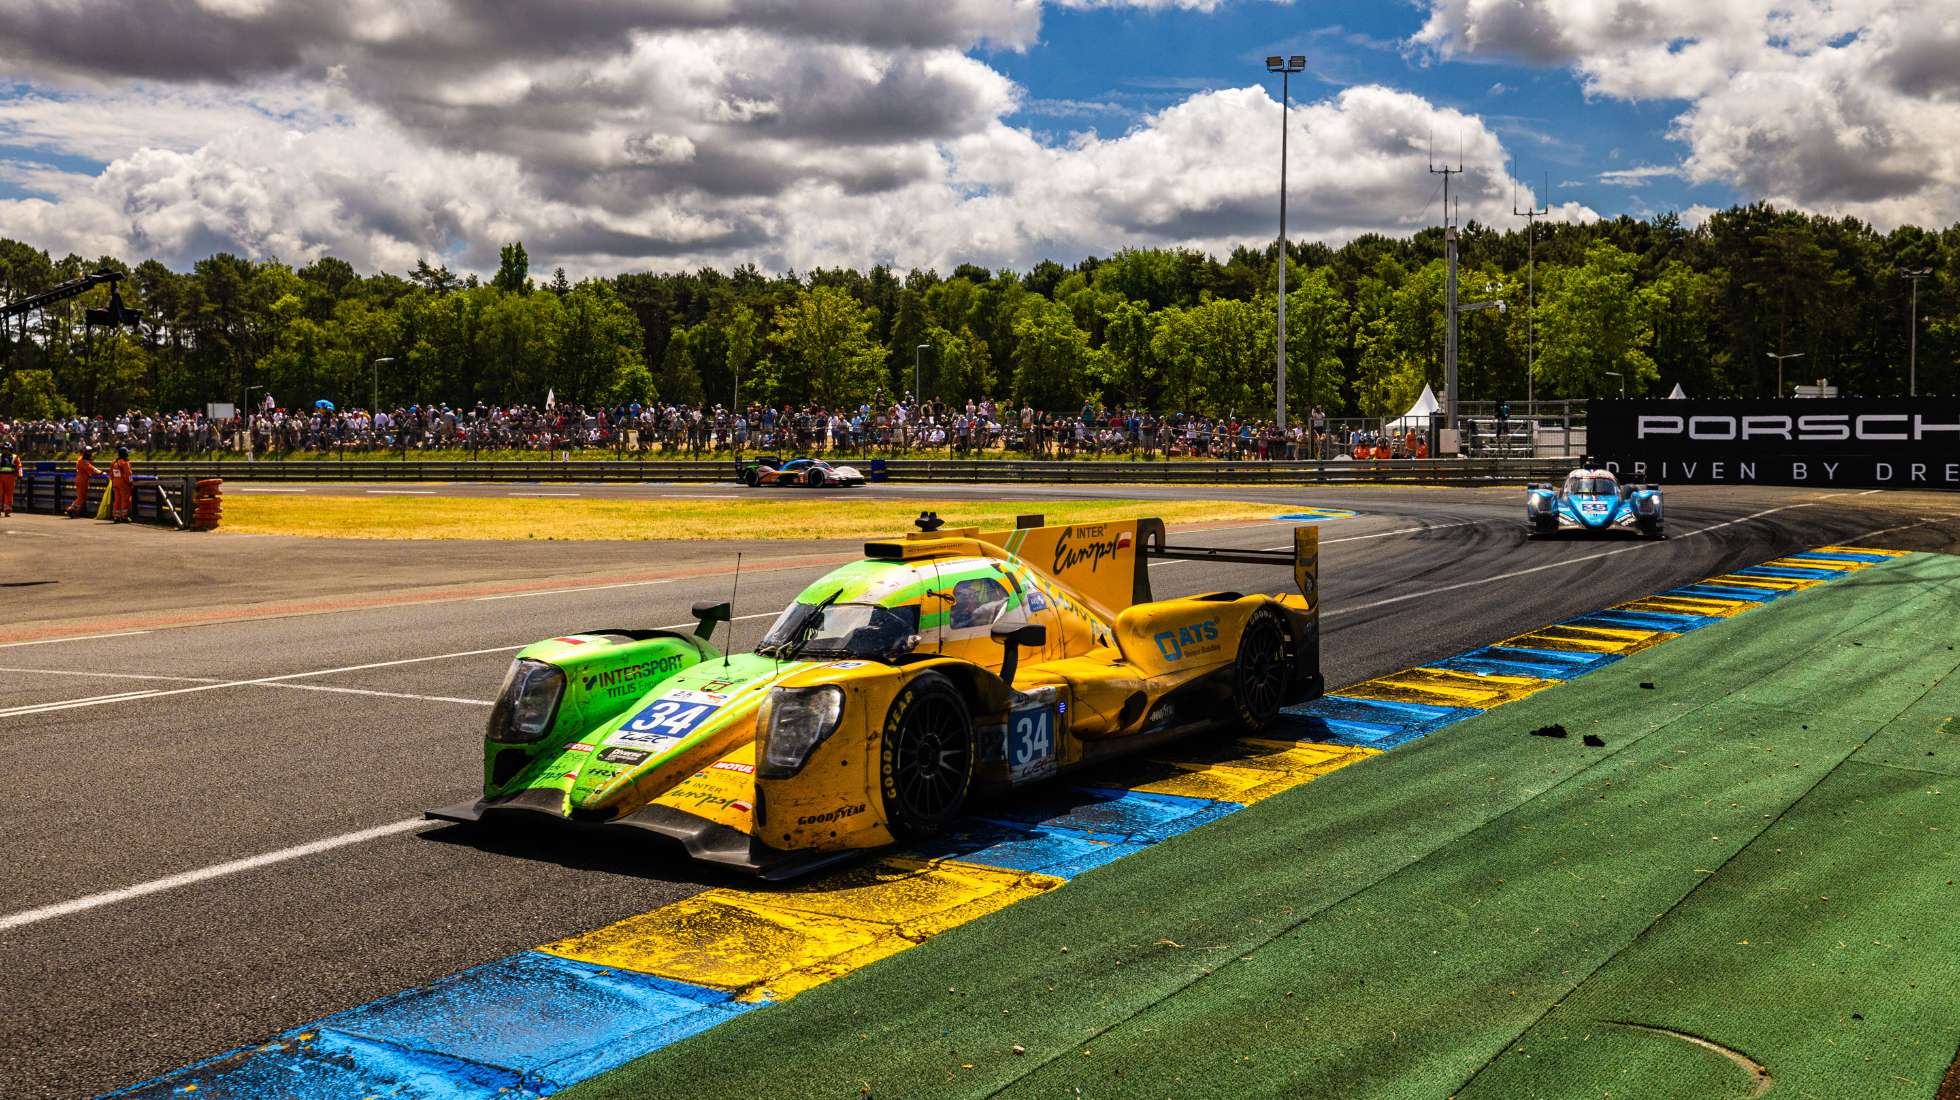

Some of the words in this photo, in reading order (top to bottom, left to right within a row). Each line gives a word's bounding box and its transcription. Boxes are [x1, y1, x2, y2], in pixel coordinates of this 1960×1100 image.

[1793, 462, 1840, 480] BY
[1876, 463, 1960, 482] DRE
[1076, 526, 1104, 540] INTER
[1052, 526, 1121, 576] Europol
[598, 654, 685, 689] INTERSPORT
[607, 682, 637, 698] TITLIS
[631, 702, 709, 734] 34
[882, 690, 913, 799] GOODYEAR
[1016, 712, 1049, 764] 34
[711, 761, 755, 774] MOTUL
[797, 802, 867, 826] GOODYEAR
